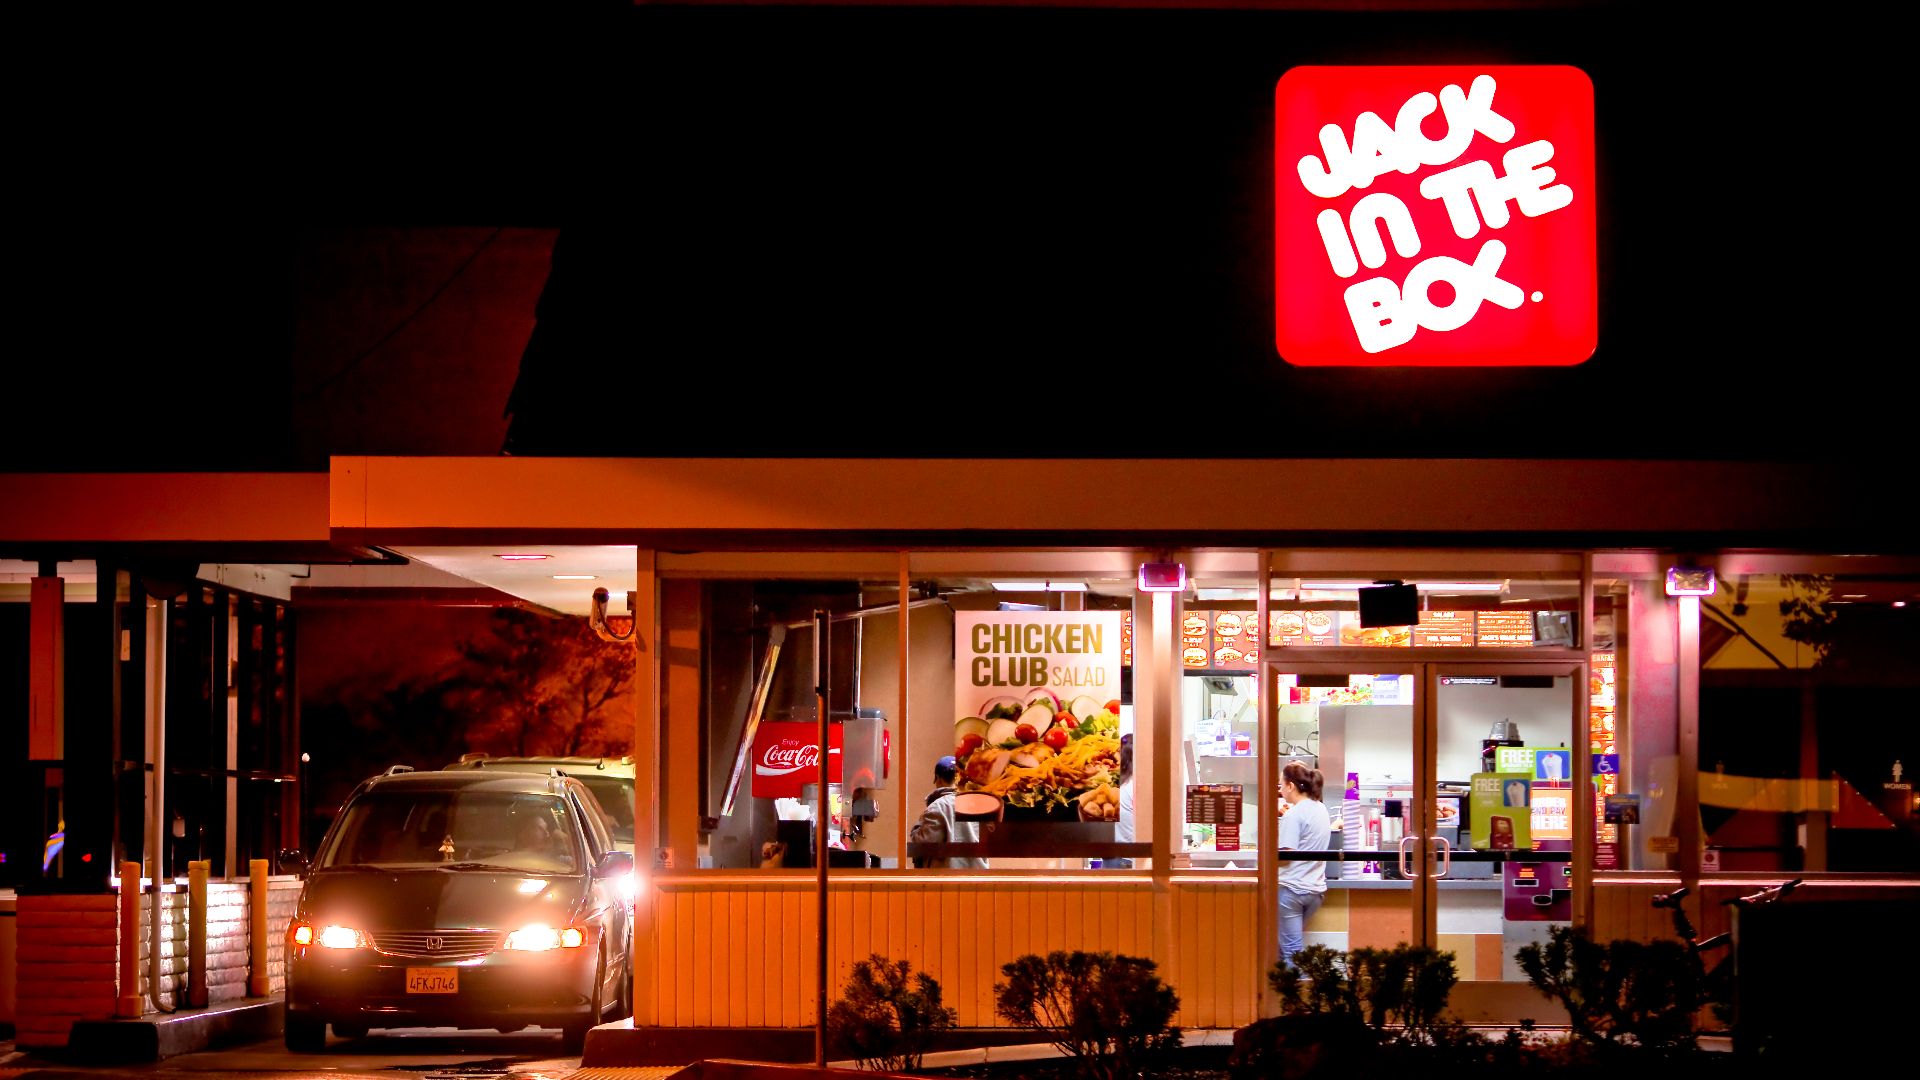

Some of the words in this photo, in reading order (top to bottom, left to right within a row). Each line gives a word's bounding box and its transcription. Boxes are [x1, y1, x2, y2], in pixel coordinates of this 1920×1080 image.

[1297, 74, 1515, 198] JACK
[1419, 139, 1574, 239] THE
[972, 623, 1103, 654] CHICKEN
[972, 656, 1049, 687] CLUB
[1052, 666, 1105, 687] SALAD
[781, 738, 800, 746] Enjoy
[763, 744, 820, 767] Coca-Col
[1501, 749, 1534, 763] FREE
[1475, 778, 1501, 792] FREE
[409, 976, 455, 991] 4FKJ746
